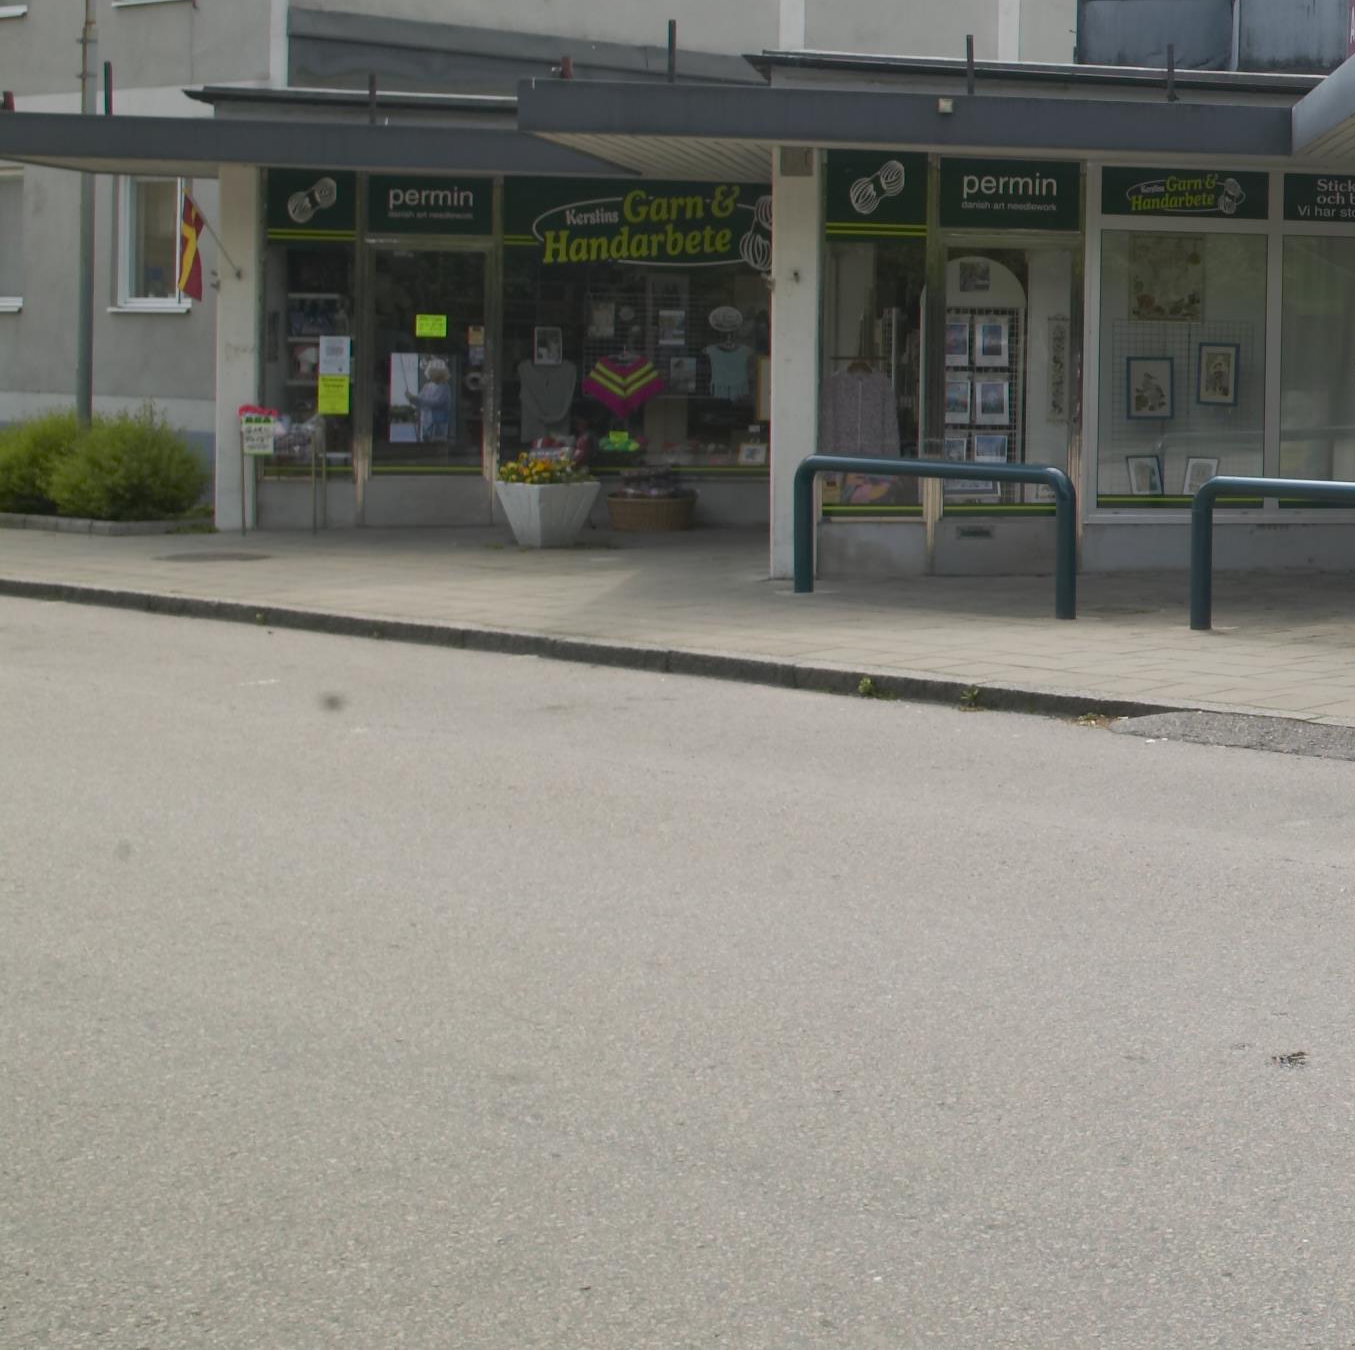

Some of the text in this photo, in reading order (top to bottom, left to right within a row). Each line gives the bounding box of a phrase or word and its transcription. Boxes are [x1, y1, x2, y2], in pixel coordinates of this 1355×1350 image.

[962, 172, 1057, 199] permin
[1166, 175, 1202, 192] Garn
[1205, 172, 1218, 189] &
[388, 186, 474, 210] permin
[565, 185, 741, 226] Kerstins Garn &
[1131, 191, 1215, 211] Handarbete
[1316, 193, 1345, 206] och
[1296, 204, 1311, 216] Vi
[1314, 206, 1336, 218] har
[542, 224, 733, 265] Handarbete
